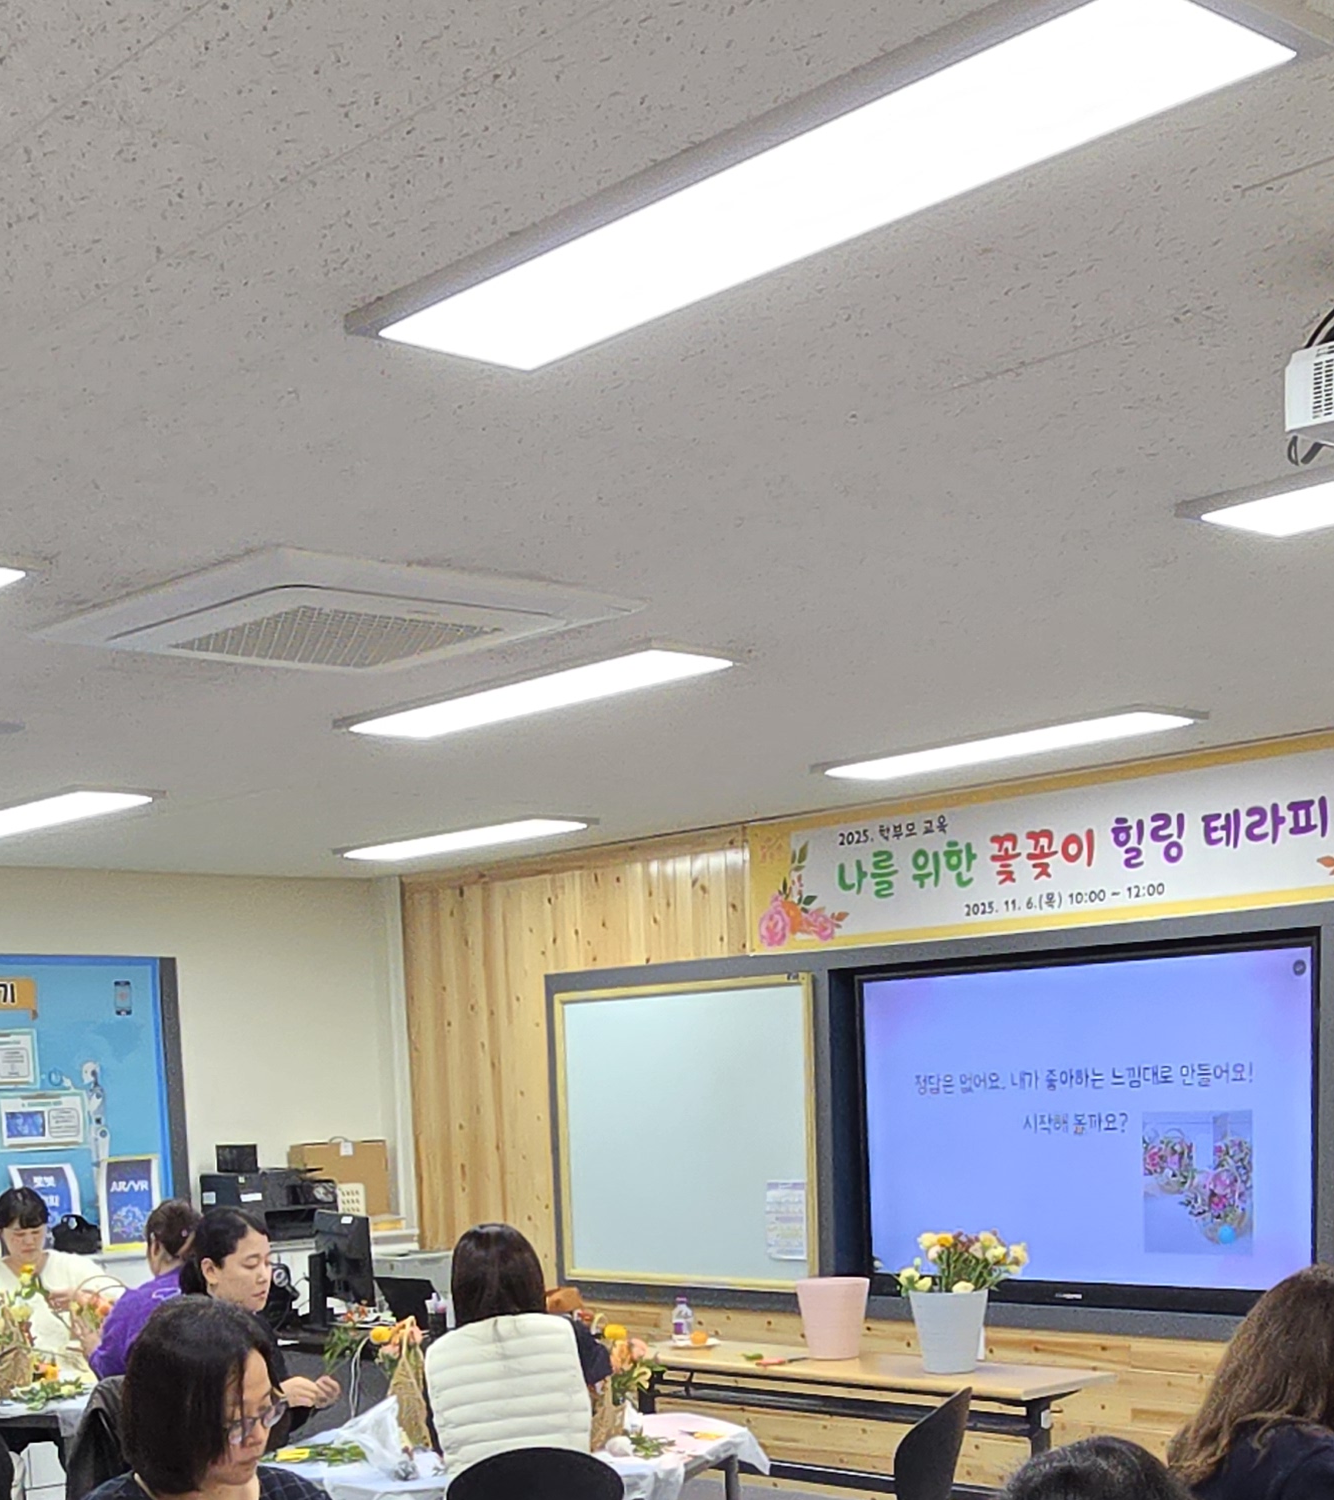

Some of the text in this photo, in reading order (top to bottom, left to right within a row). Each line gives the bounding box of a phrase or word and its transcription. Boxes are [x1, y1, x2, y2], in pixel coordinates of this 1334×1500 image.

[838, 814, 949, 846] 2025. 학부모 교육
[837, 795, 1329, 899] 나를 위한 꽃꽂이 힐링 테라피
[965, 901, 999, 916] 2025.
[1004, 899, 1021, 912] 11.
[1068, 889, 1107, 905] 10:00
[1127, 882, 1166, 899] 12:00
[915, 1073, 955, 1096] 정답은
[1011, 1069, 1039, 1091] 내가
[1045, 1067, 1105, 1092] 좋아하는
[1111, 1064, 1174, 1089] 느낌대로
[1180, 1061, 1254, 1087] 만들어요!
[1023, 1112, 1068, 1135] 시작해
[110, 1180, 149, 1192] AR/VR
